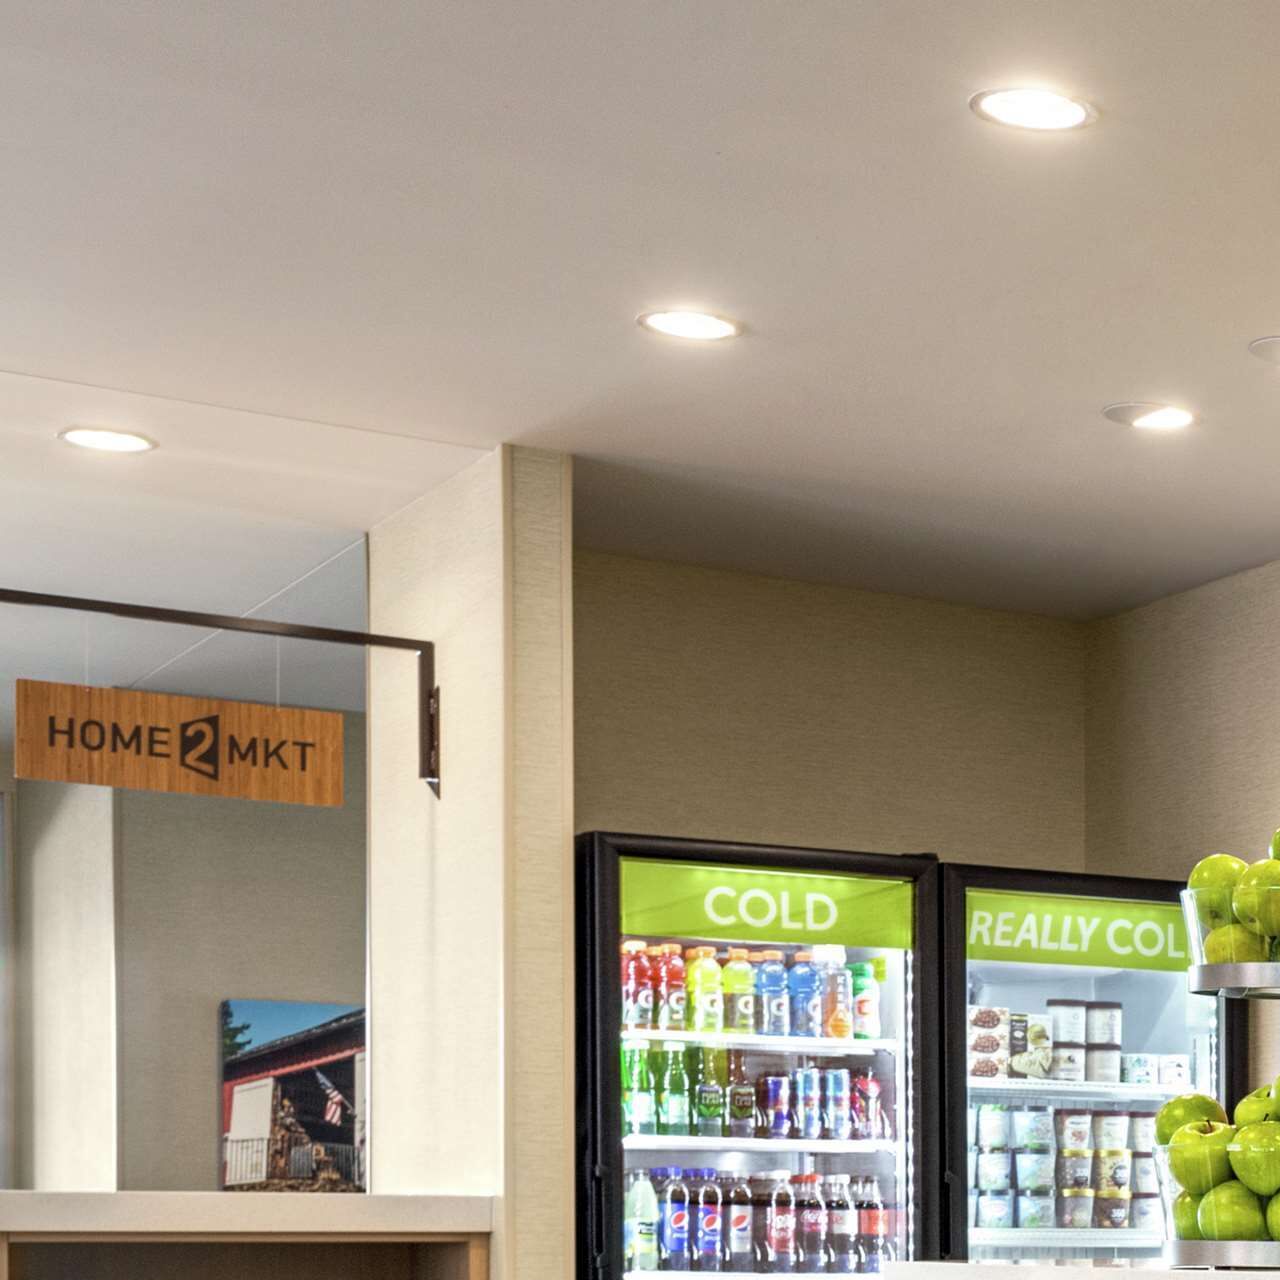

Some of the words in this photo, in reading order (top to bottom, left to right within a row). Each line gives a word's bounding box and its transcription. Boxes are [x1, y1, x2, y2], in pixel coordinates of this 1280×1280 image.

[48, 715, 171, 758] HOME
[227, 735, 316, 772] MKT
[704, 886, 838, 931] COLD
[969, 910, 1101, 953] REALLY
[1106, 918, 1185, 959] COL
